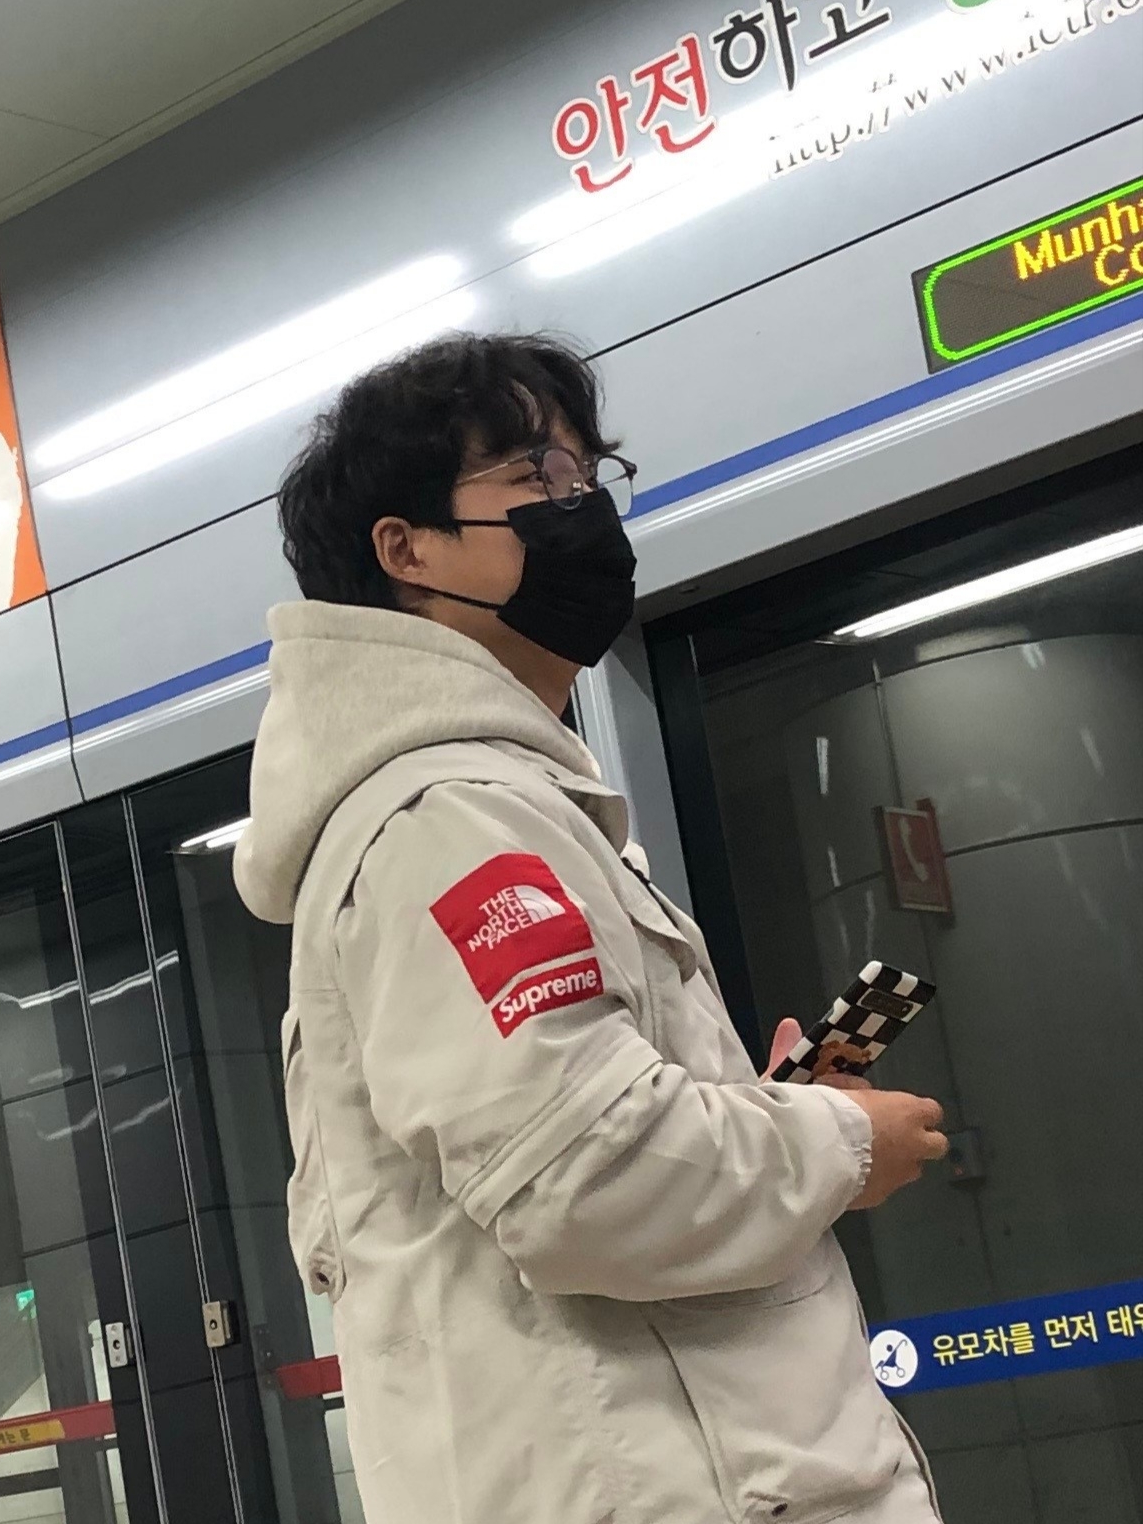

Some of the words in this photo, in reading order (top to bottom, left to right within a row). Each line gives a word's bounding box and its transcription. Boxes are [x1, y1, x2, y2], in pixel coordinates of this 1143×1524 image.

[1014, 198, 1143, 280] Munh
[467, 900, 526, 952] NORTH
[479, 885, 517, 916] THE
[486, 913, 533, 950] FACE
[498, 969, 598, 1024] Supreme
[933, 1321, 1036, 1366] 유모차를
[1044, 1311, 1098, 1349] 먼저
